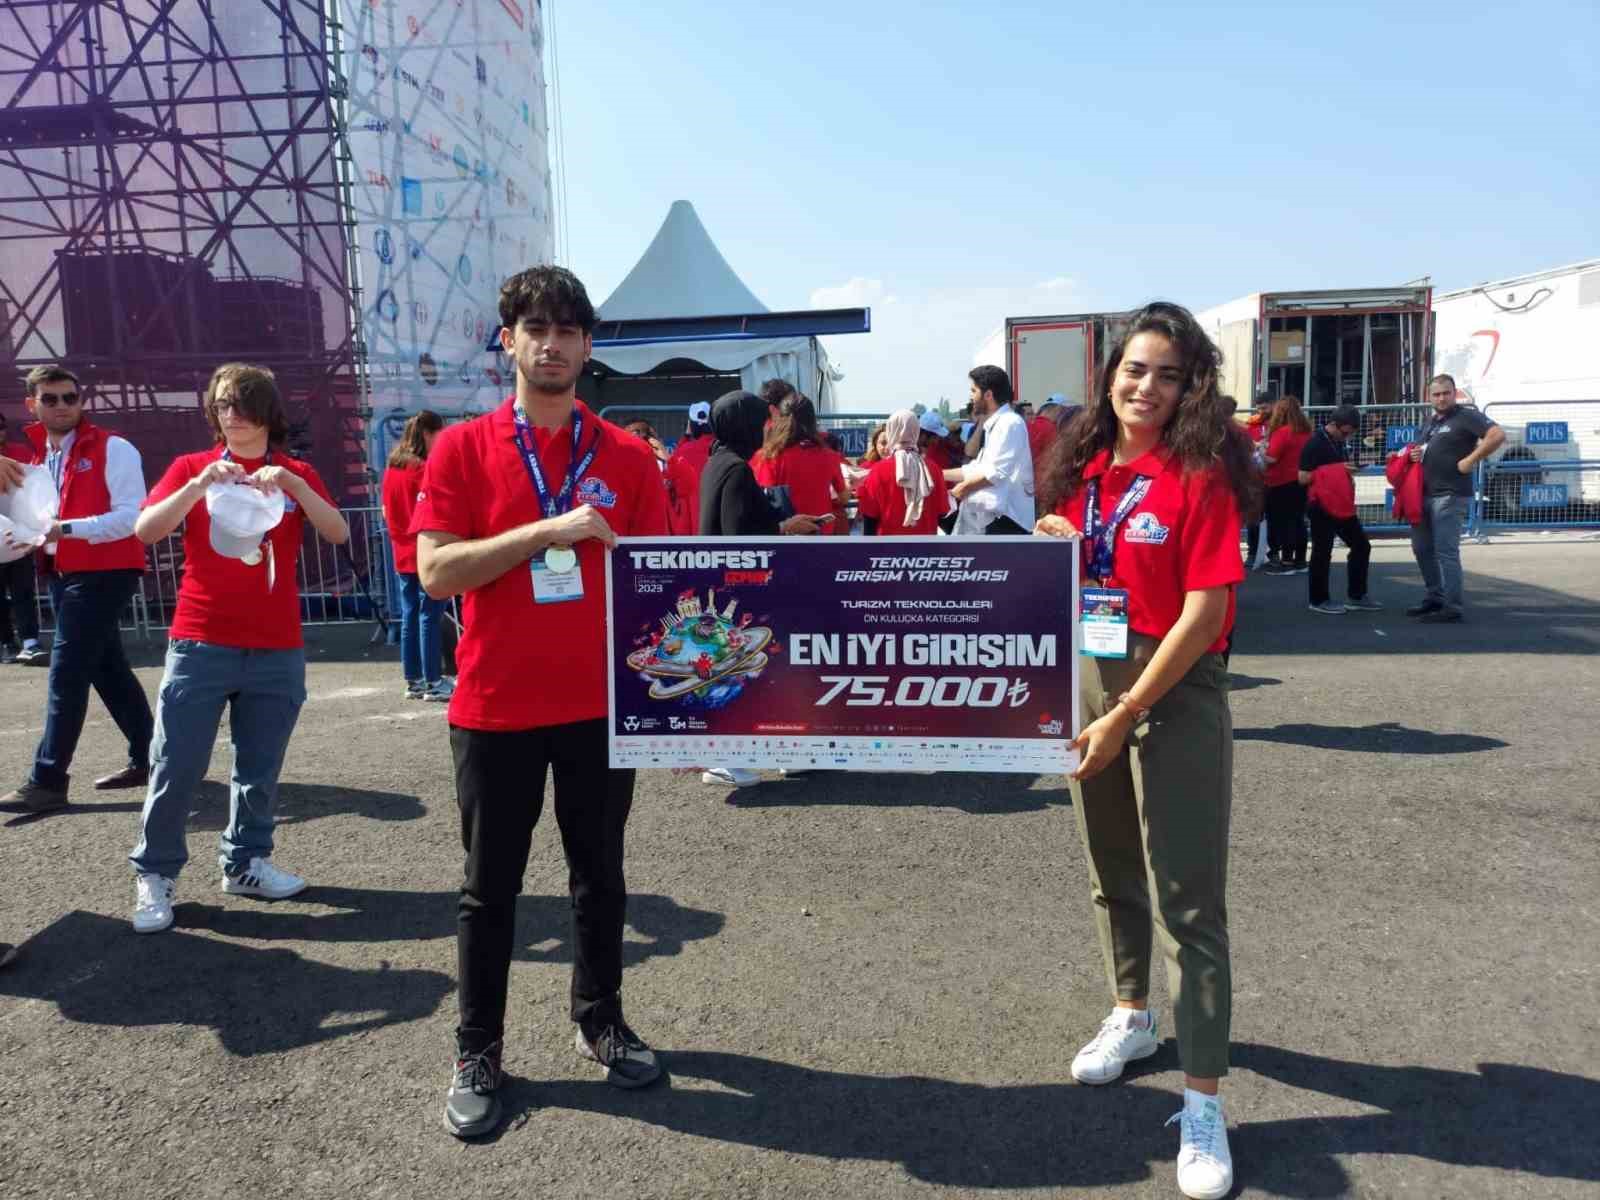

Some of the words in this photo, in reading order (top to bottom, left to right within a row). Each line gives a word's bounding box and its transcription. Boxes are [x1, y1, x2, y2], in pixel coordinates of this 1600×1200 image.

[629, 550, 769, 569] TEKNOFEST
[869, 556, 976, 569] TEKNOFEST
[906, 570, 1009, 583] YARIŞMASI
[638, 584, 663, 593] 2023
[789, 633, 840, 665] EN
[846, 633, 897, 665] İYİ
[902, 633, 1057, 668] GİRİŞİM
